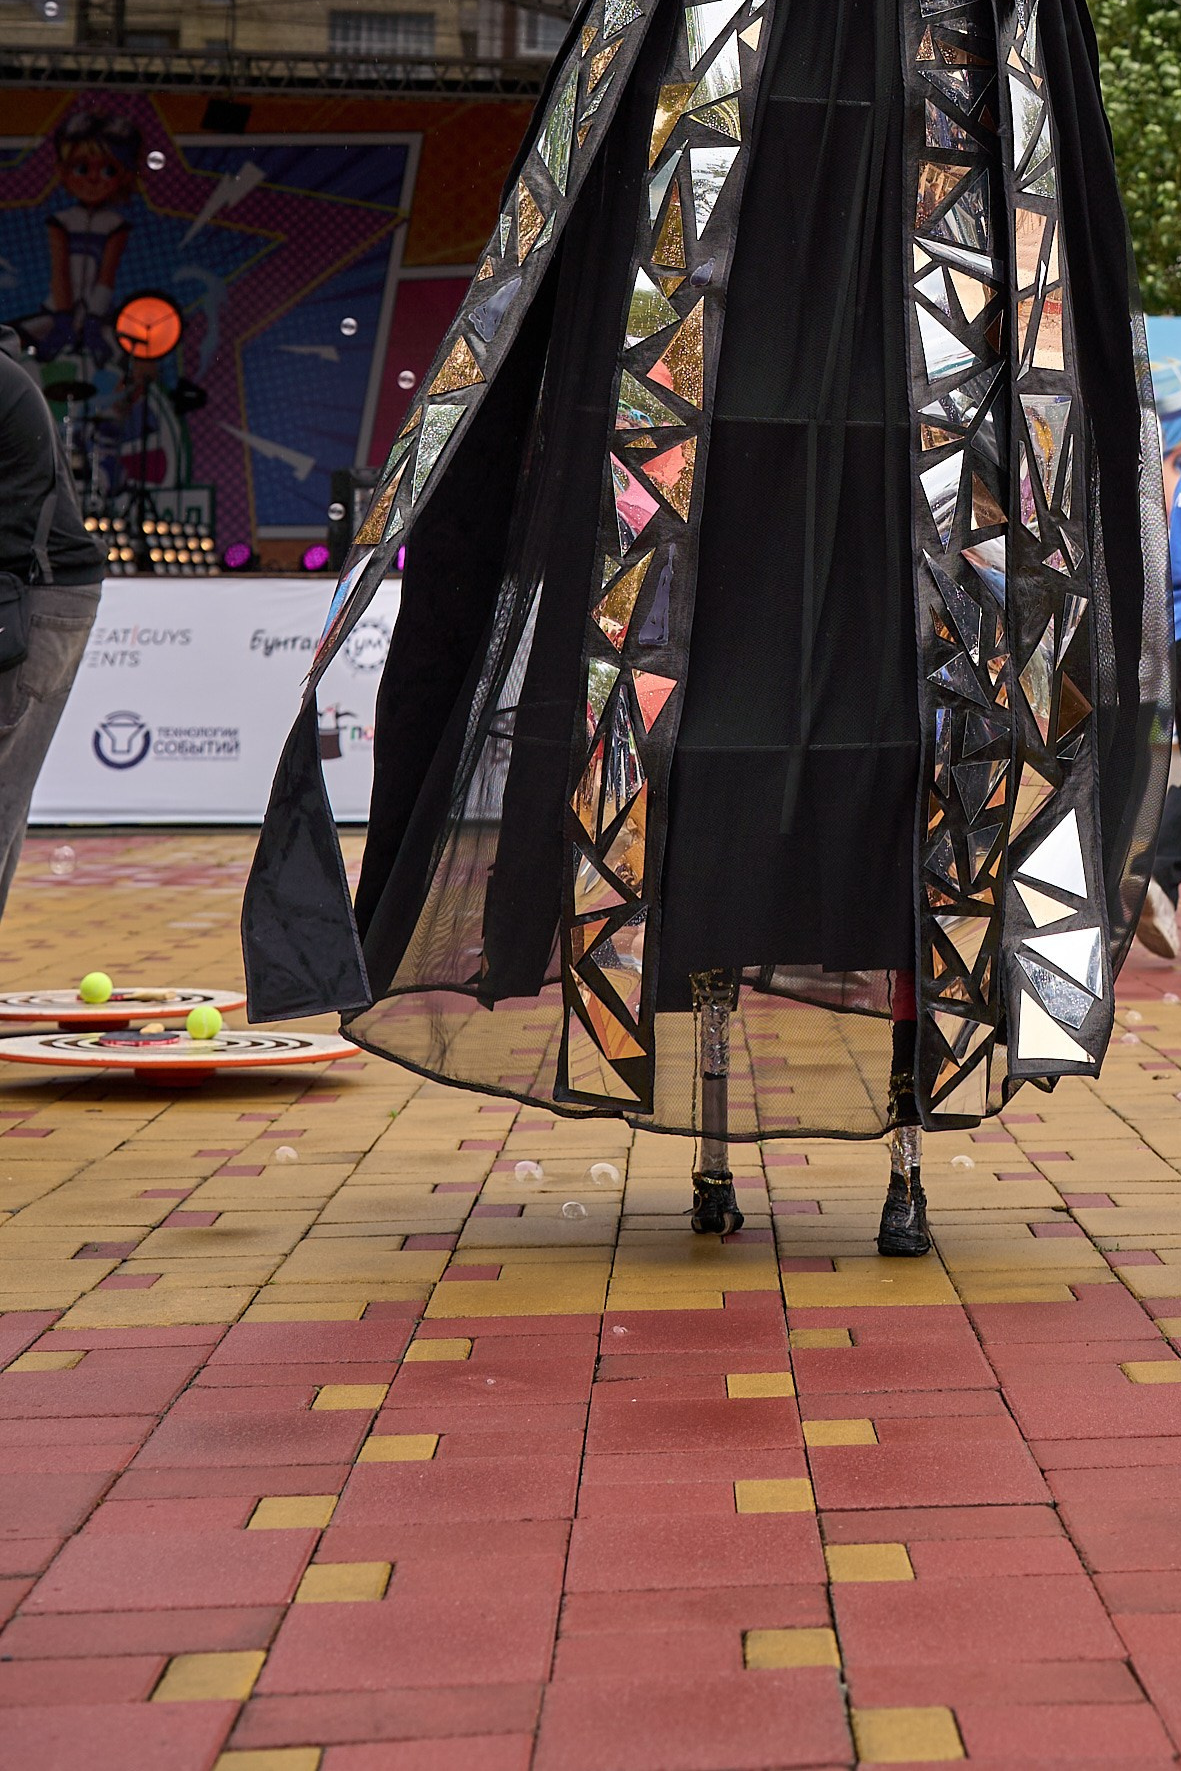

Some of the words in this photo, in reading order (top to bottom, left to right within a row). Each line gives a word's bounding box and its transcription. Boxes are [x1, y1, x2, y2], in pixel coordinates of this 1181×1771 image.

[250, 629, 317, 658] Бунта
[86, 650, 142, 669] ENTS
[157, 726, 239, 738] ТЕХНОЛОГИИ
[153, 738, 240, 755] СОБЫТИЙ
